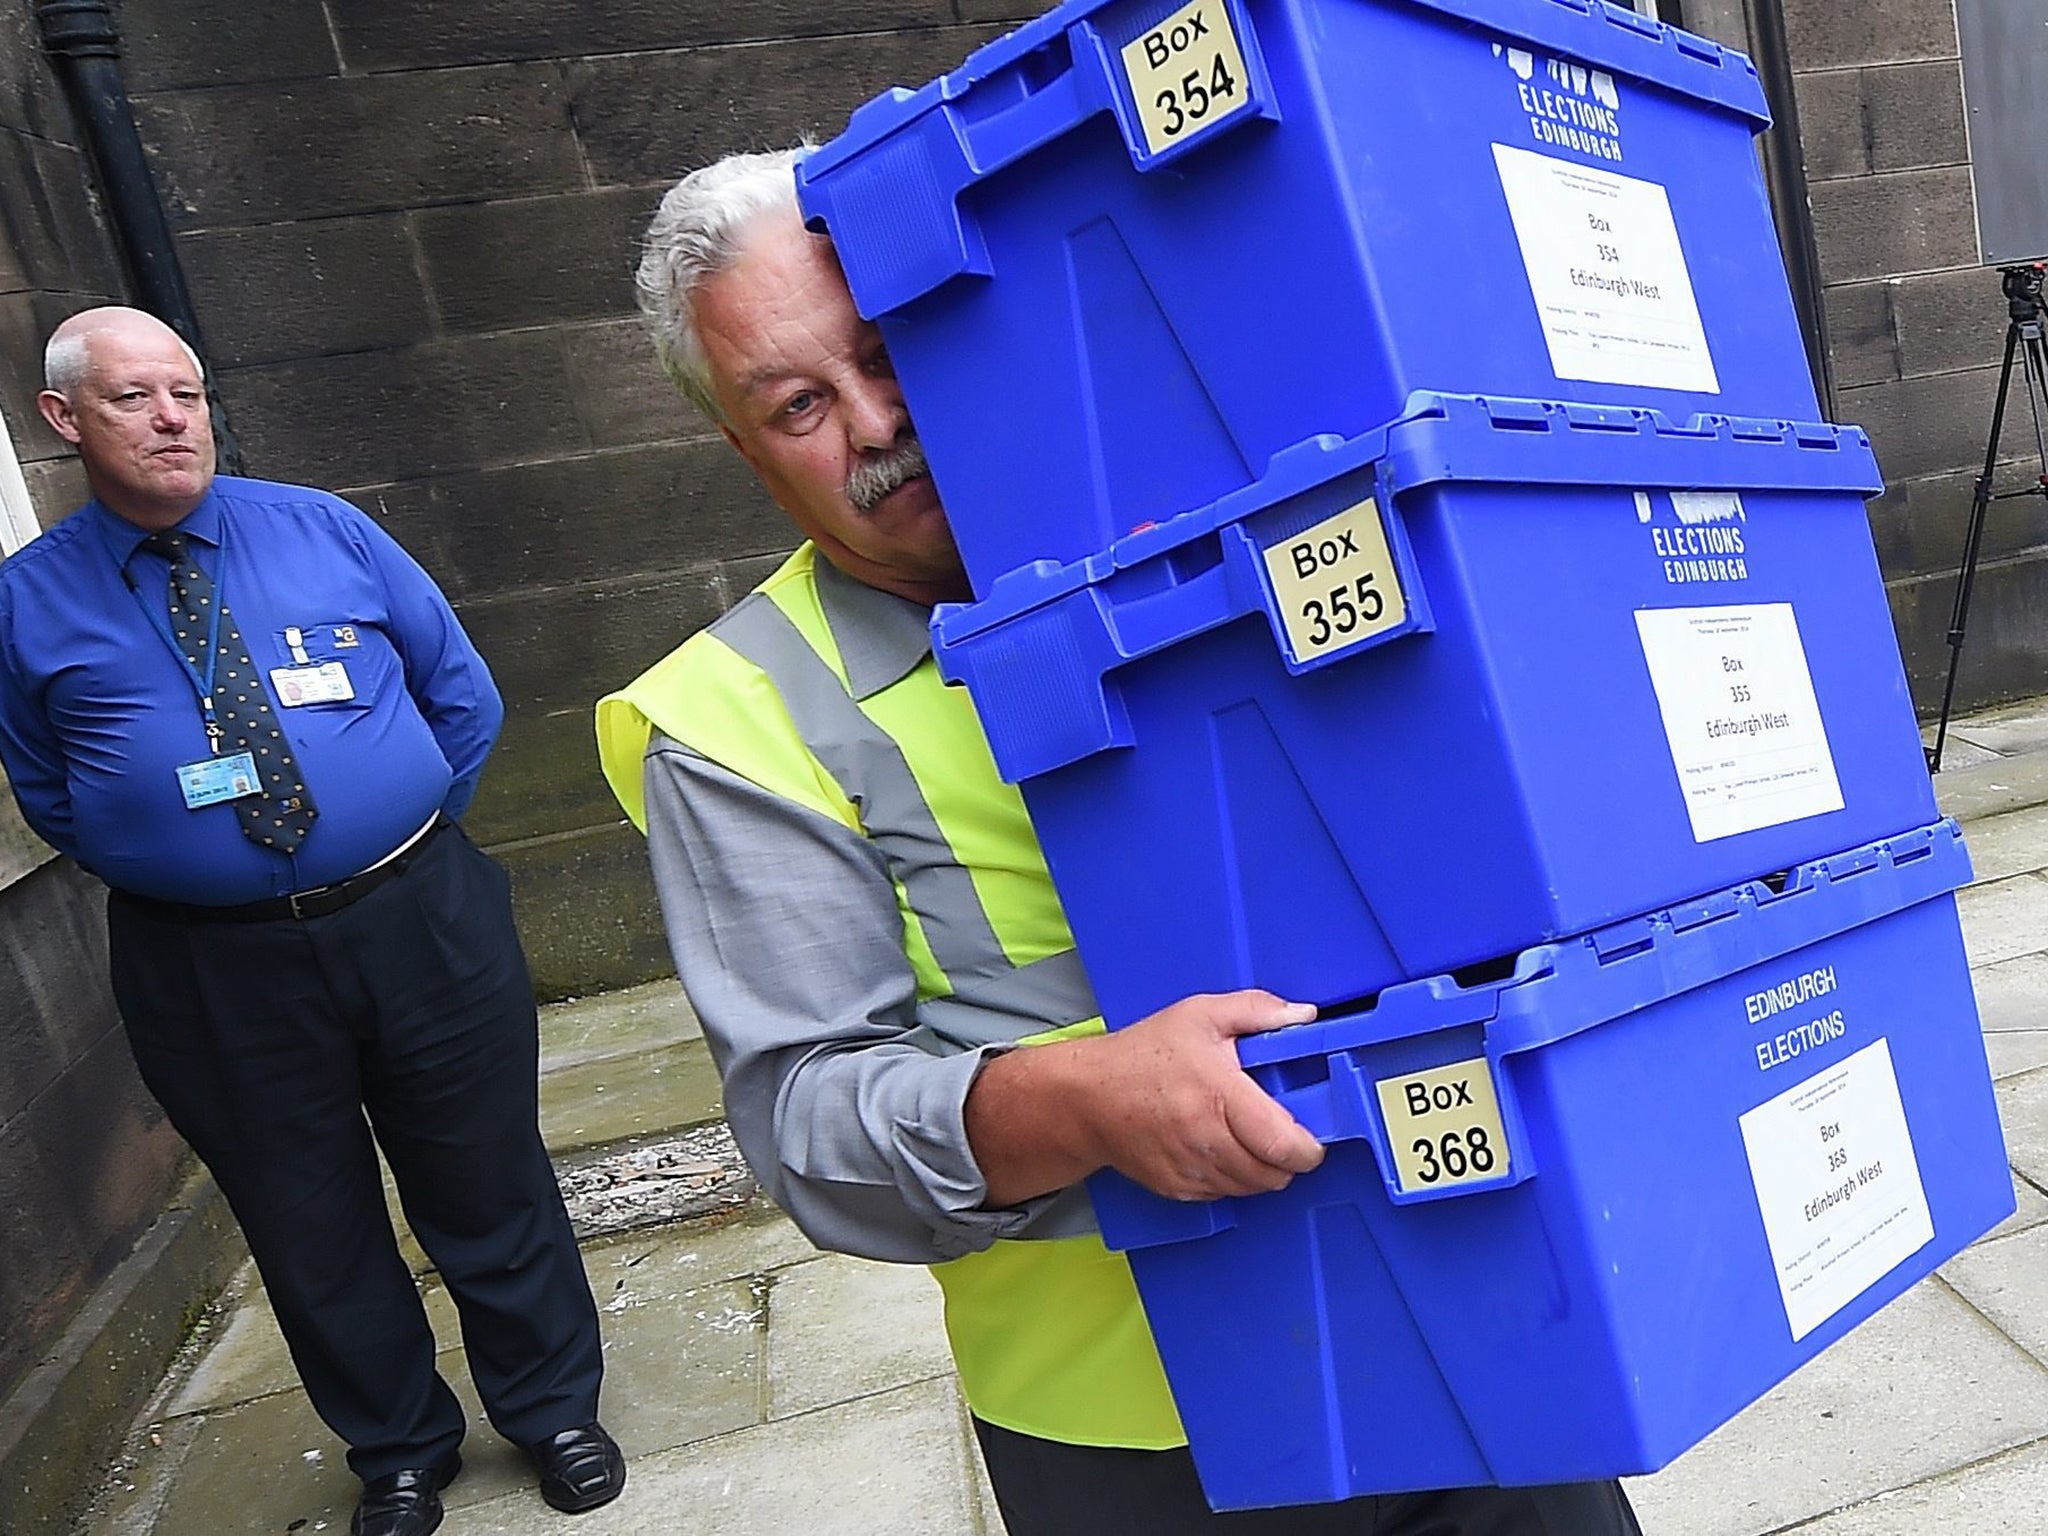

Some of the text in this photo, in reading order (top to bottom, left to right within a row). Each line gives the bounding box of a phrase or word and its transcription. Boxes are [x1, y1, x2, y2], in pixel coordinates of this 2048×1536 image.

[1143, 10, 1209, 70] Box
[1156, 52, 1235, 136] 354
[1517, 83, 1619, 137] ELECTIONS
[1530, 117, 1622, 161] EDINBURGH
[1588, 212, 1612, 233] Box
[1596, 243, 1619, 262] 354
[1570, 267, 1661, 300] Edinburgh West
[1291, 529, 1360, 580] Box
[1652, 527, 1745, 557] ELECTIONS
[1664, 558, 1748, 583] EDINBURGH
[1303, 572, 1383, 646] 355
[1721, 655, 1744, 673] Box
[1730, 684, 1751, 704] 355
[1706, 711, 1790, 739] Edinburgh West
[1744, 965, 1838, 1024] EDINBURGH
[1755, 1010, 1846, 1071] ELECTIONS
[1404, 1080, 1474, 1117] Box
[1820, 1122, 1841, 1143] Box
[1412, 1126, 1494, 1183] 368
[1828, 1147, 1848, 1172] 368
[1804, 1160, 1884, 1222] Edinburgh West
